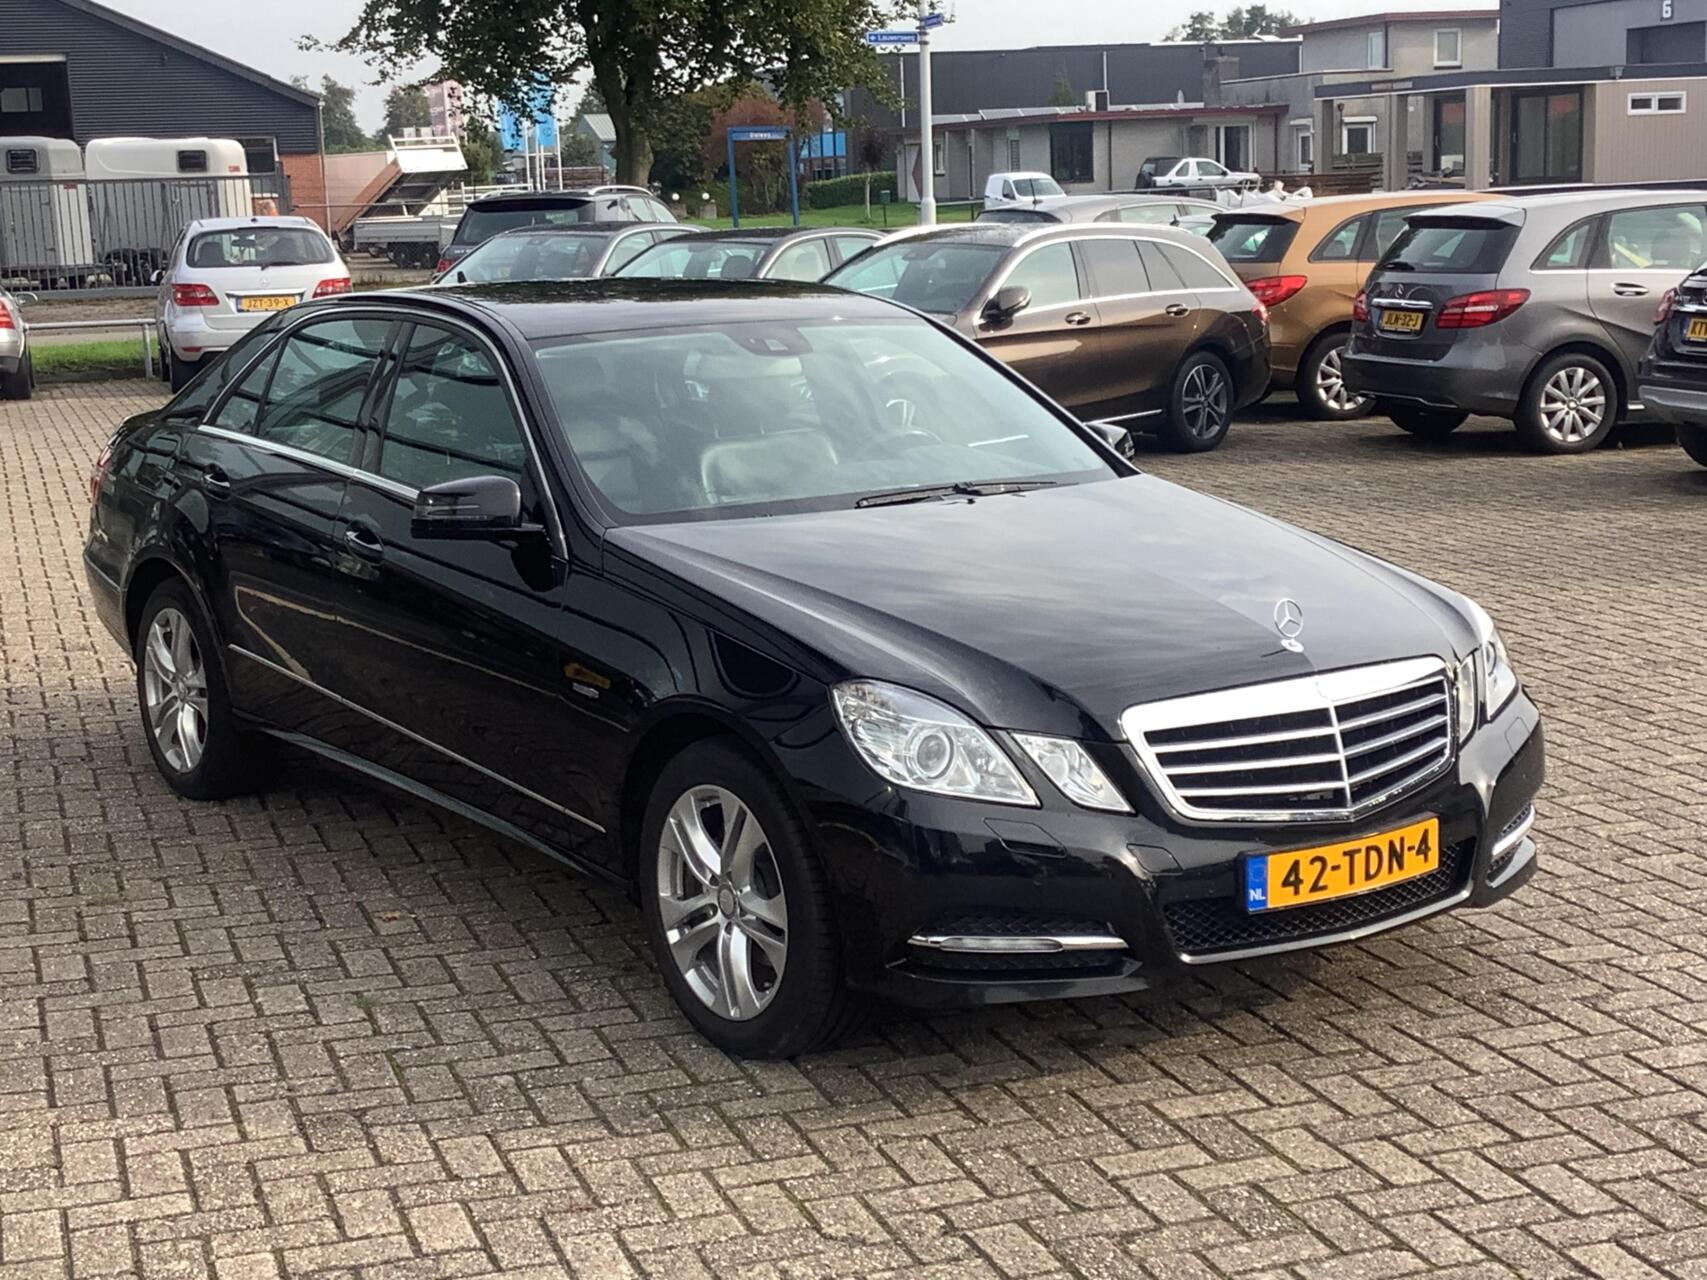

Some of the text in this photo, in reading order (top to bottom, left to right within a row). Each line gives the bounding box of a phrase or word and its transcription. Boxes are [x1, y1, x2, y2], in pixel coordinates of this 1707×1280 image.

[1662, 0, 1672, 18] 6
[1690, 320, 1707, 336] KT
[1281, 828, 1431, 896] 42-TDN-4
[1249, 888, 1266, 901] NL
